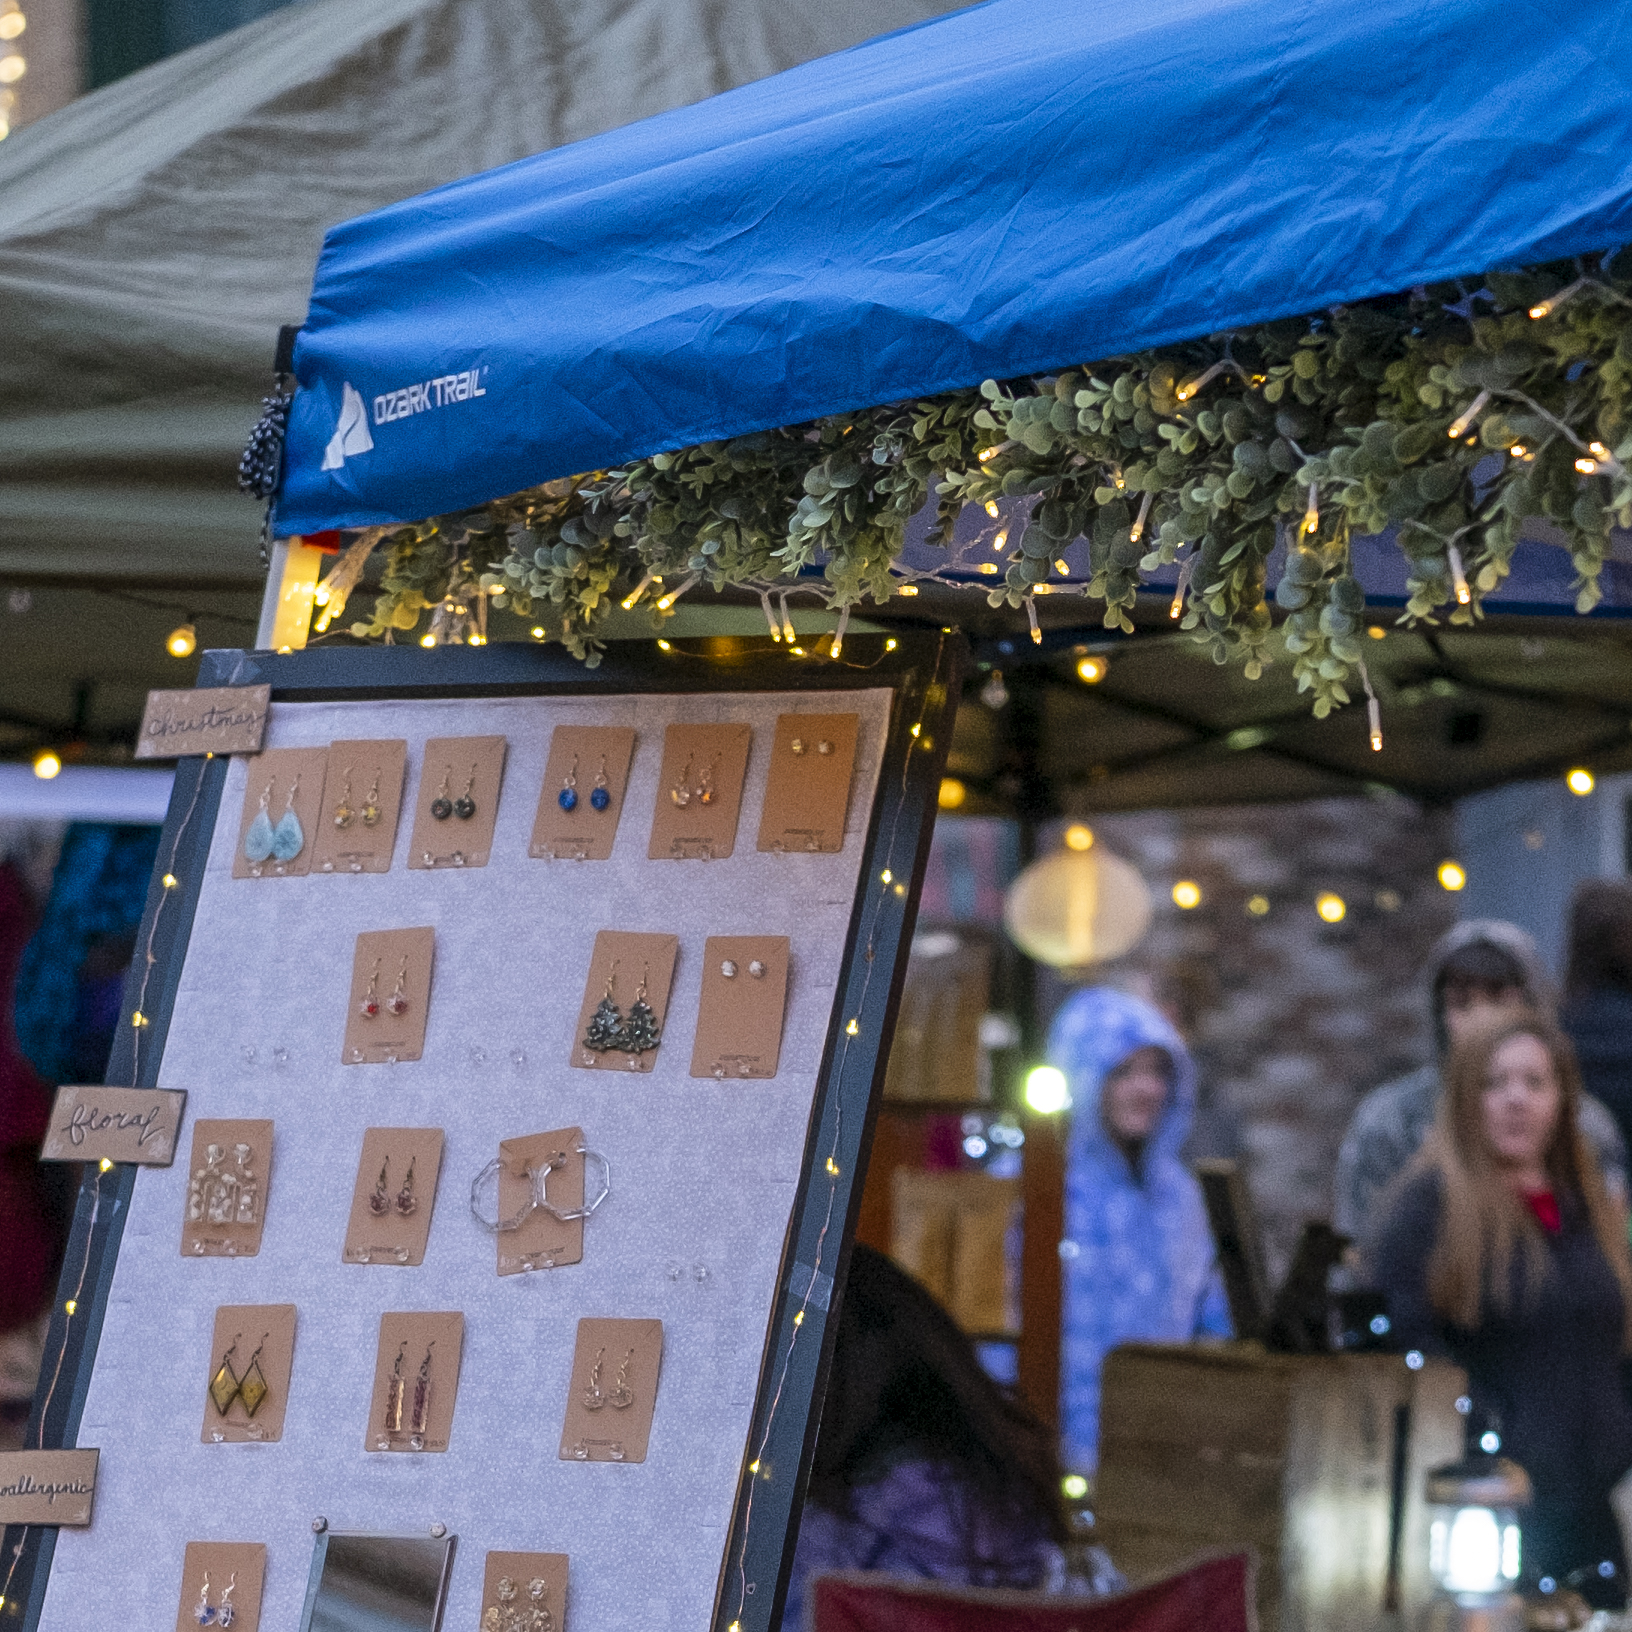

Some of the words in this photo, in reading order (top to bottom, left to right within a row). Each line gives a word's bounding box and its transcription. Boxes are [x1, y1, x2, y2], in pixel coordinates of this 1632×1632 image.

[374, 381, 432, 426] OZARK
[432, 368, 486, 407] TRAIL
[62, 1103, 166, 1147] floral
